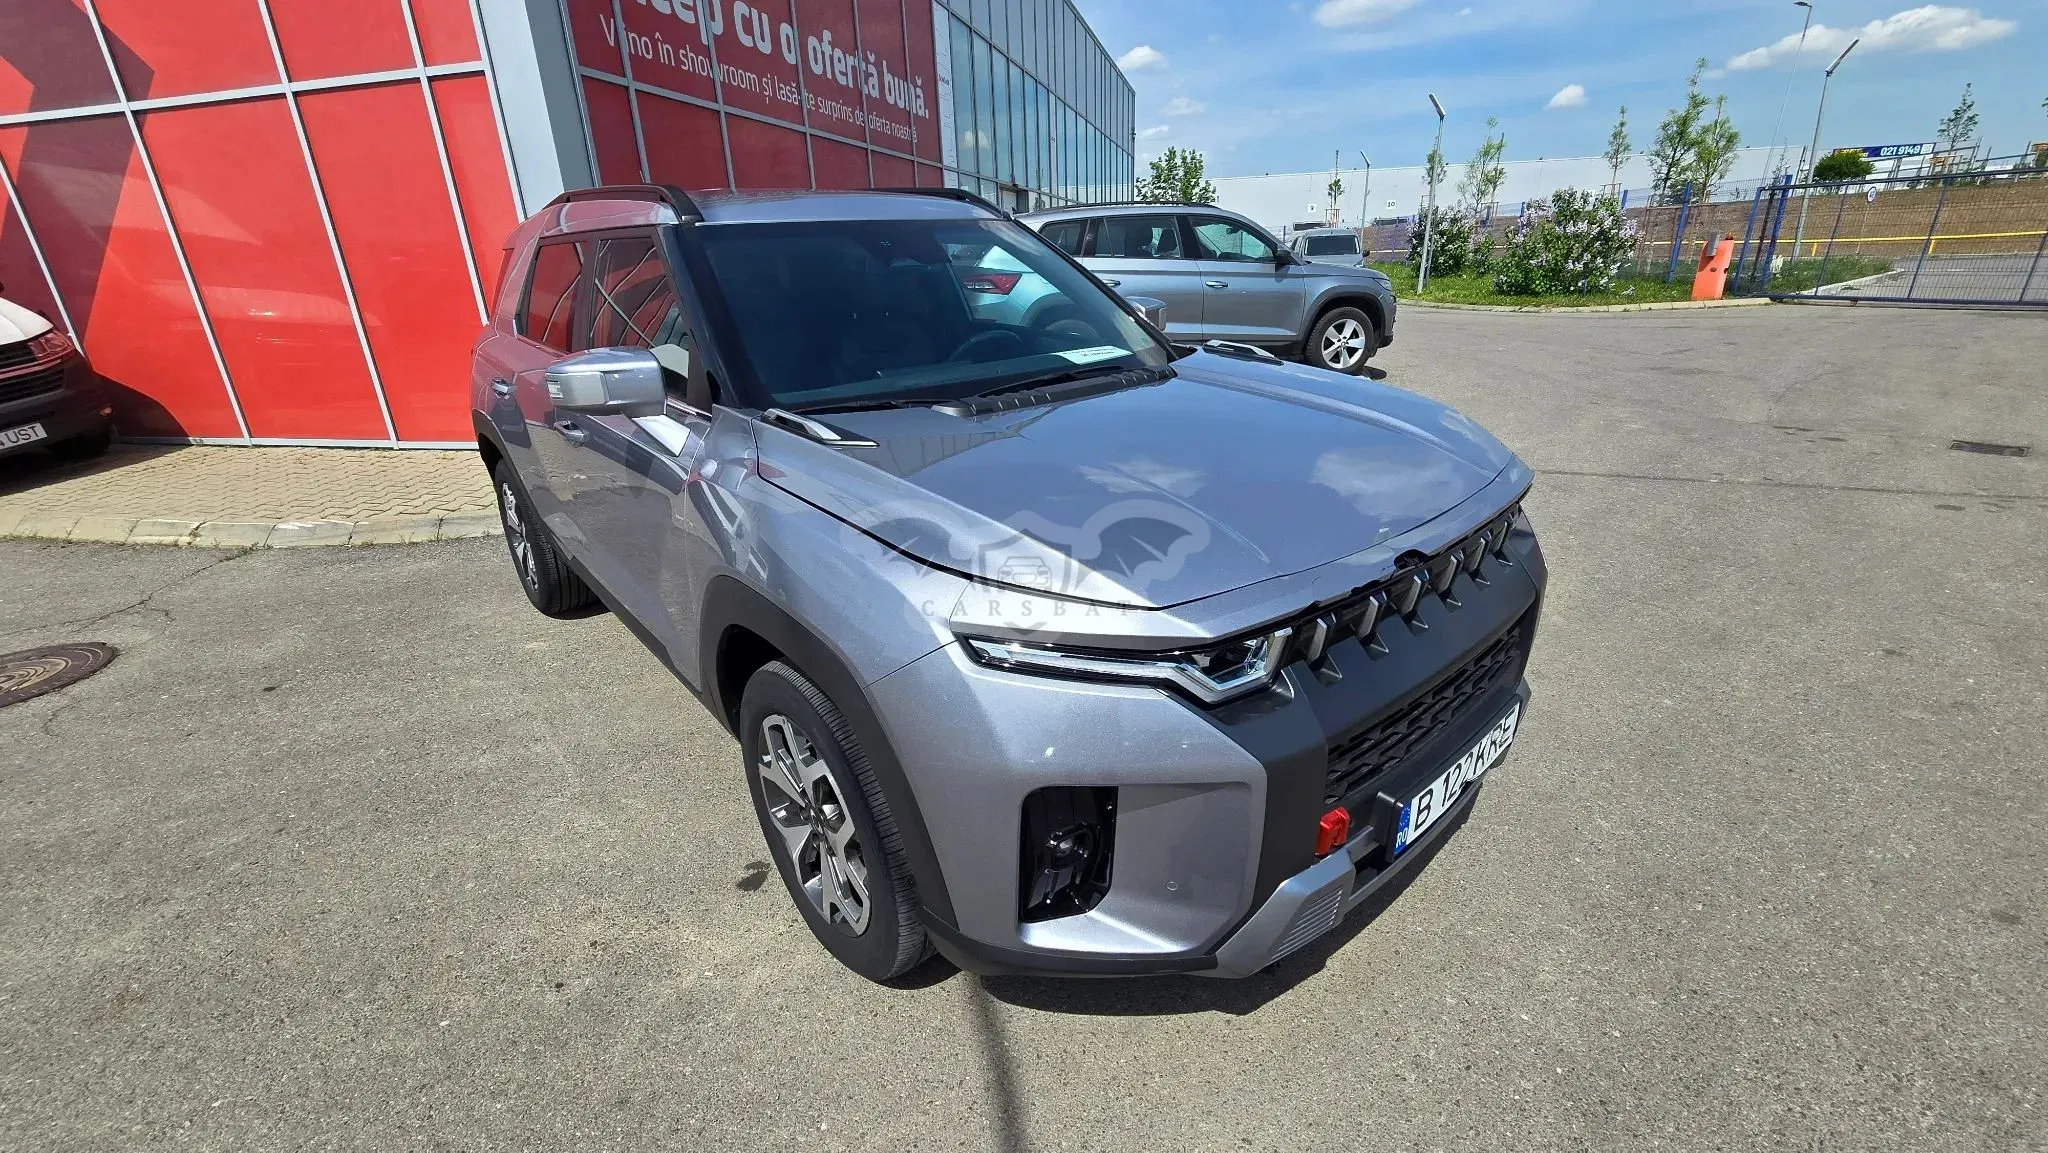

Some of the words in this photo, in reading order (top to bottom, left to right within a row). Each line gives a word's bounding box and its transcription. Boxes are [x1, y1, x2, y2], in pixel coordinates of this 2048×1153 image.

[733, 0, 772, 55] cu
[779, 22, 797, 65] o
[807, 29, 880, 99] ofertă
[883, 60, 929, 119] bună.
[655, 31, 675, 66] în
[817, 96, 853, 123] surprins
[855, 106, 865, 127] de
[1880, 147, 1897, 156] 021
[1897, 145, 1921, 155] 9149
[4, 425, 39, 443] UST
[1414, 788, 1434, 833] B
[1395, 827, 1409, 849] RO
